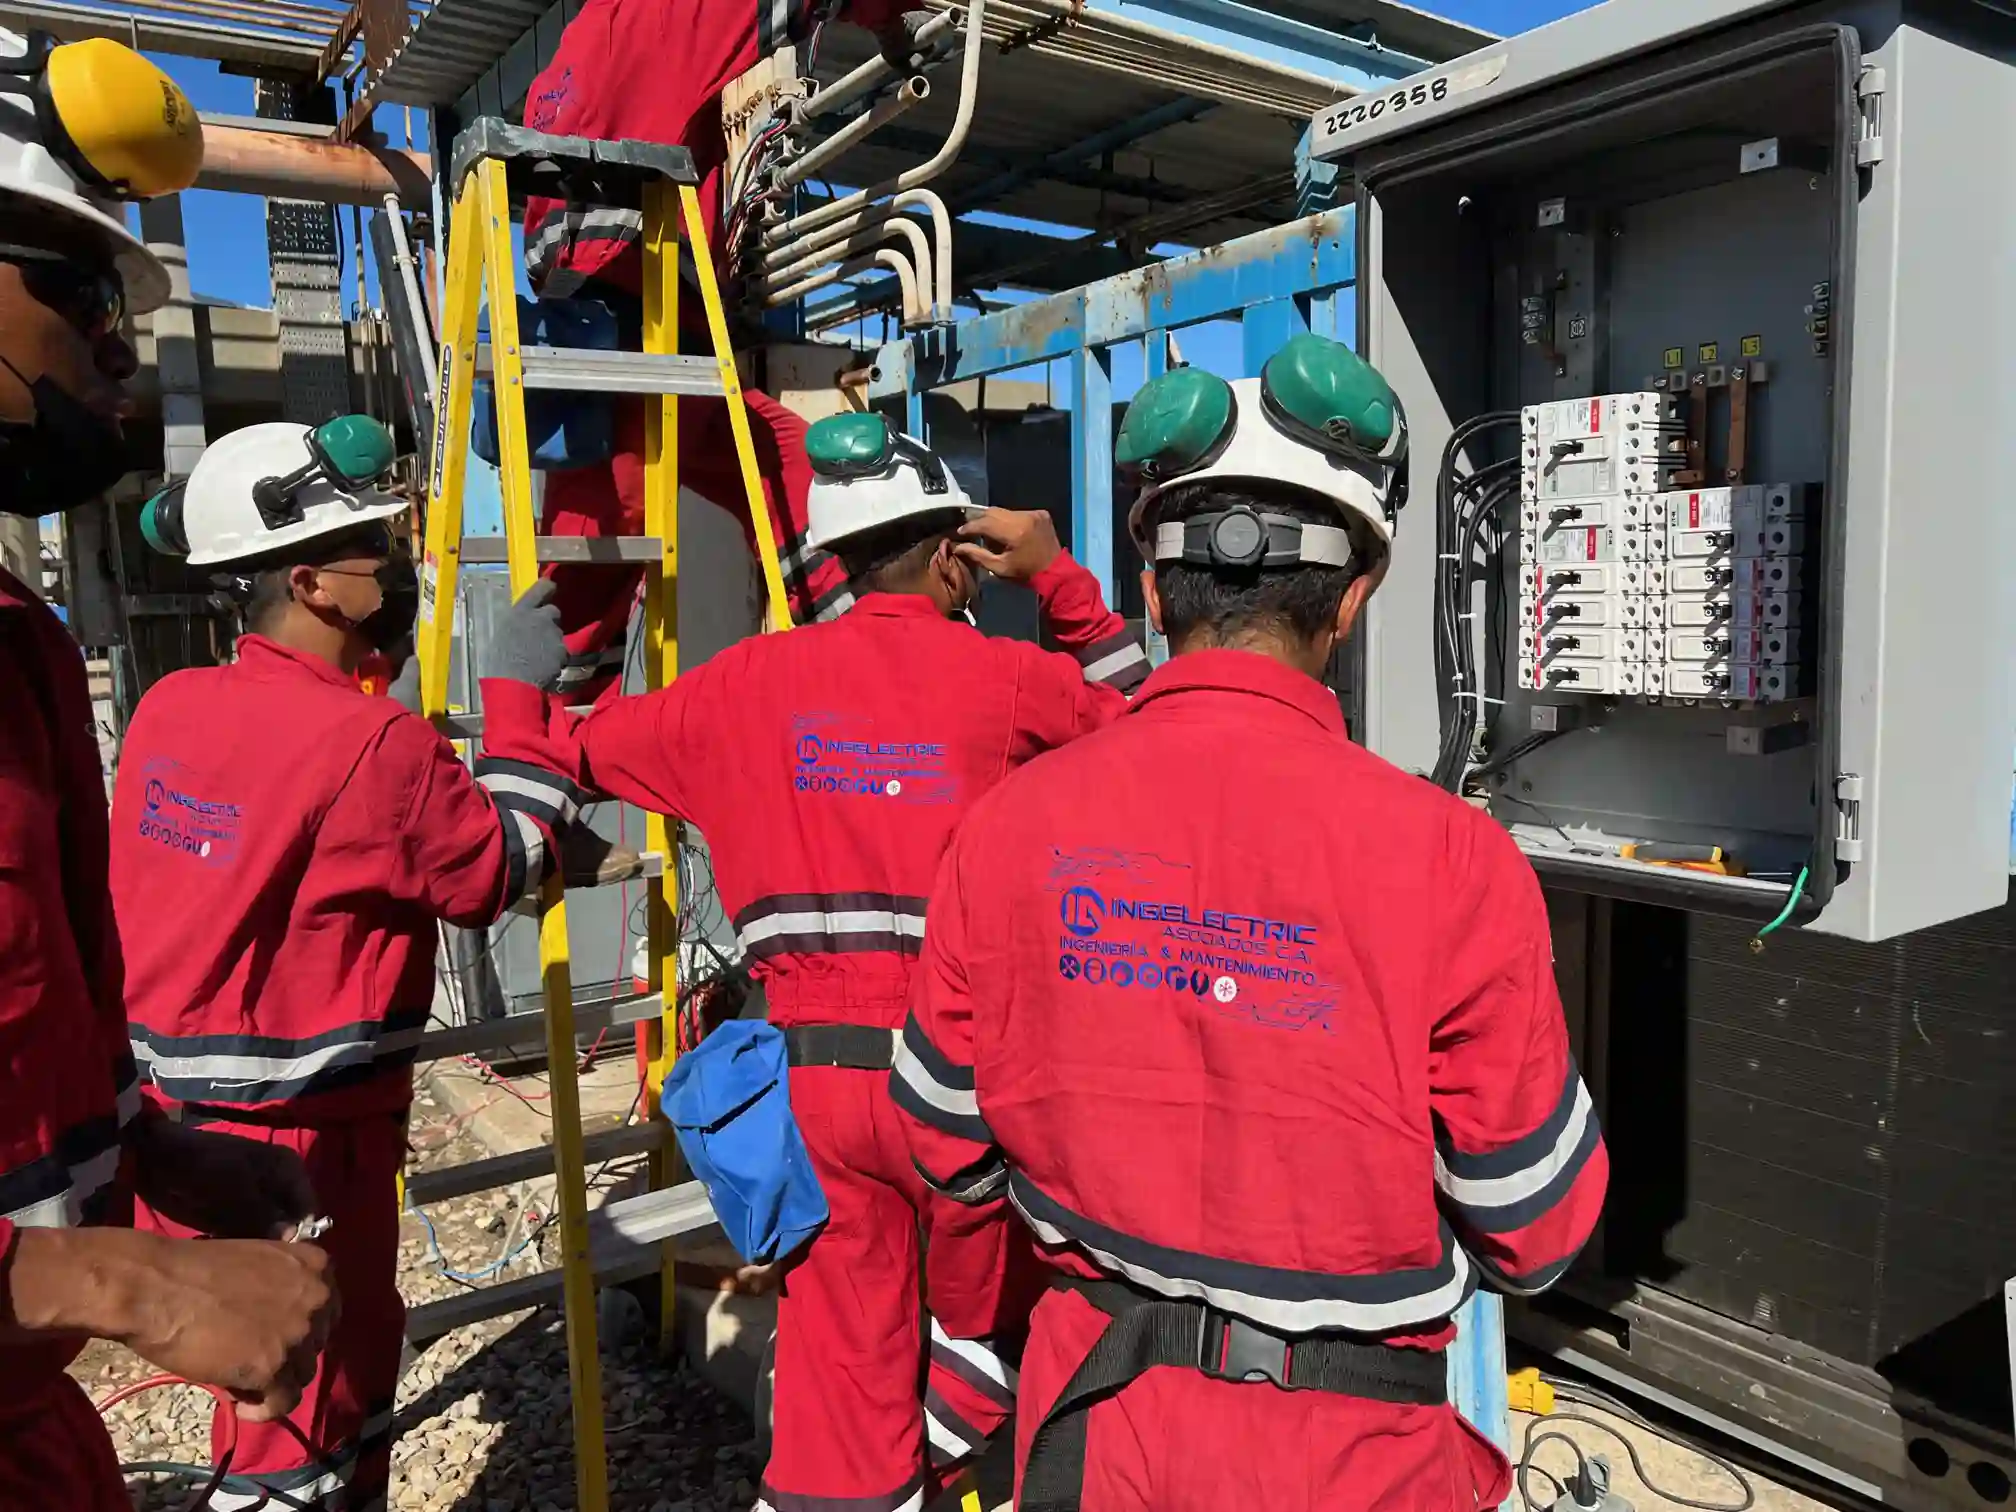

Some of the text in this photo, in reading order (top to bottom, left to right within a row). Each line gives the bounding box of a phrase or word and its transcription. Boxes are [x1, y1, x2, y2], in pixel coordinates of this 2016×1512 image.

[1325, 77, 1448, 136] 2220358
[1111, 897, 1317, 946] INGELECTRIC
[1162, 924, 1269, 956] ASOCIADOS
[1180, 948, 1316, 987] MANTENIMIENTO
